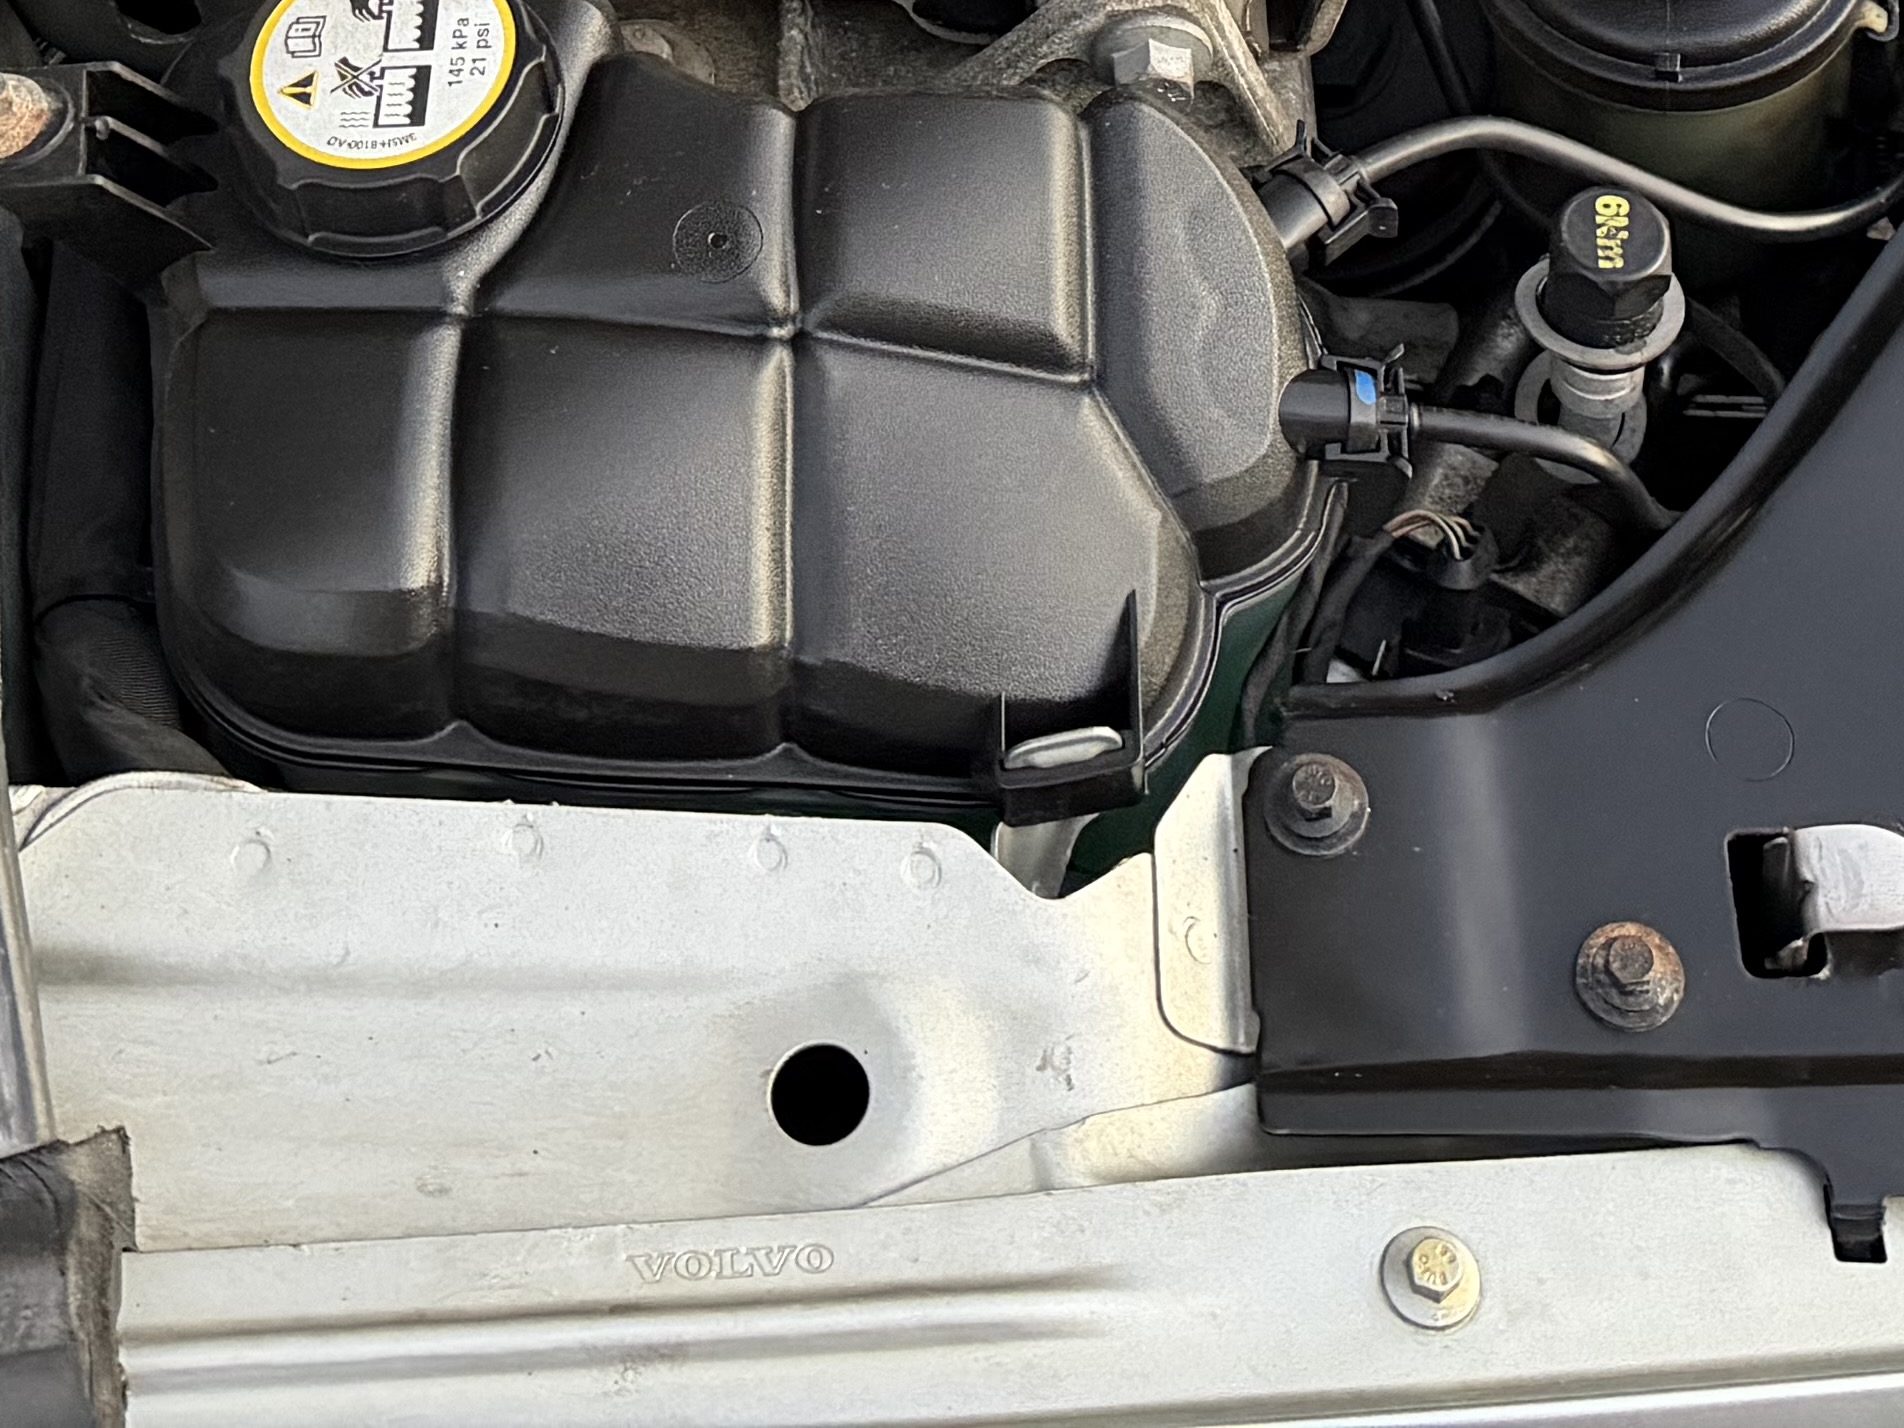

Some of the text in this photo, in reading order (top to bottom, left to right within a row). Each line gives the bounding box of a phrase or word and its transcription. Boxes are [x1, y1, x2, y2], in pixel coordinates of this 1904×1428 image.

[448, 17, 470, 87] 145 kPa
[469, 22, 491, 76] 21 psi
[626, 1242, 834, 1284] VOLVO
